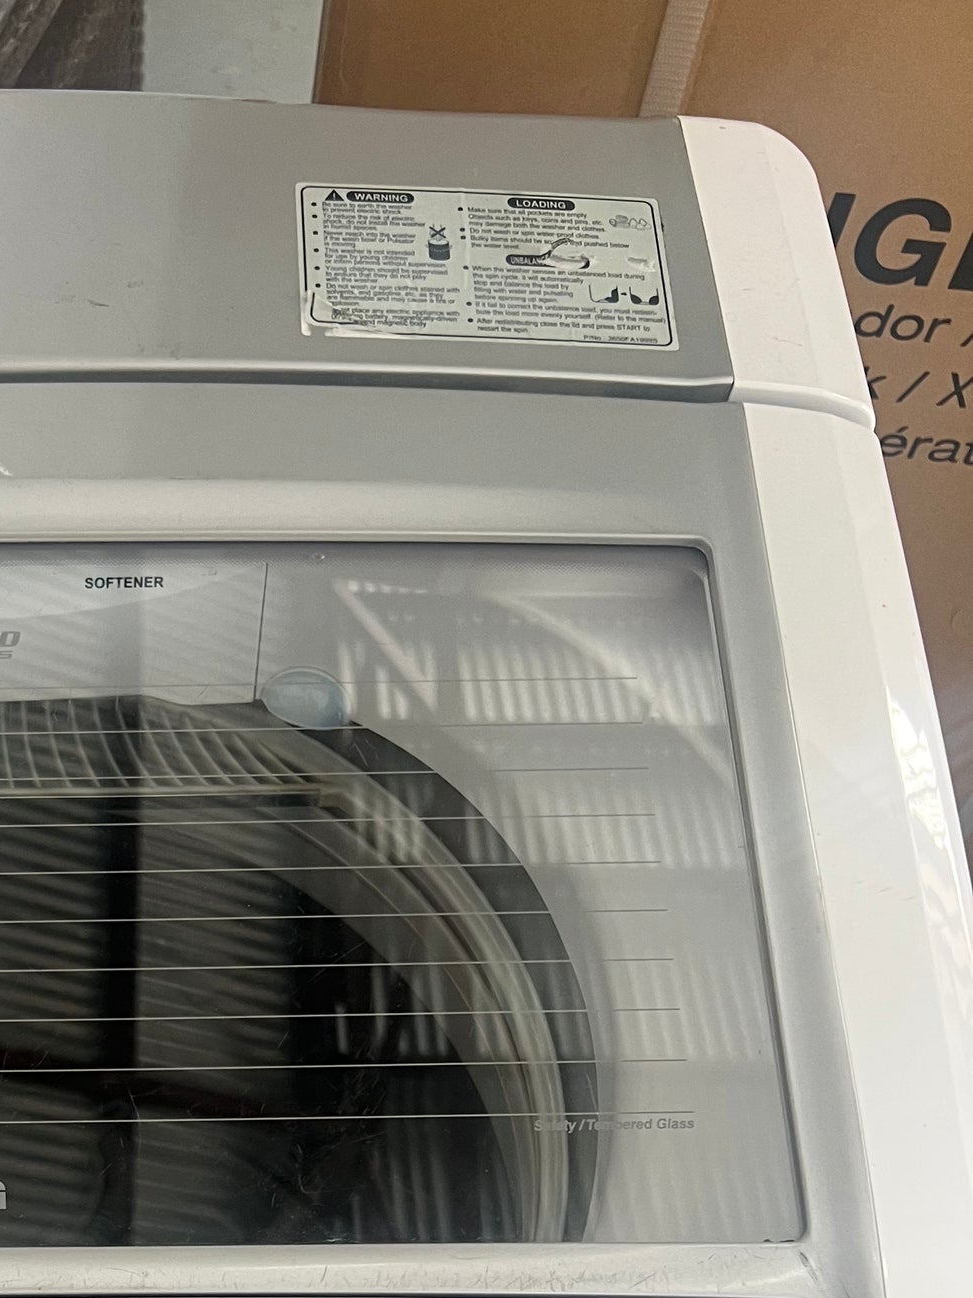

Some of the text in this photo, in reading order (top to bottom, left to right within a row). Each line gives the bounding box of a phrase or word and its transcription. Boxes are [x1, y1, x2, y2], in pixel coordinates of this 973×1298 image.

[354, 193, 408, 202] WARNING
[516, 200, 566, 209] LOADING
[827, 192, 973, 292] IG
[84, 576, 164, 589] SOFTENER
[656, 1118, 695, 1129] Glass
